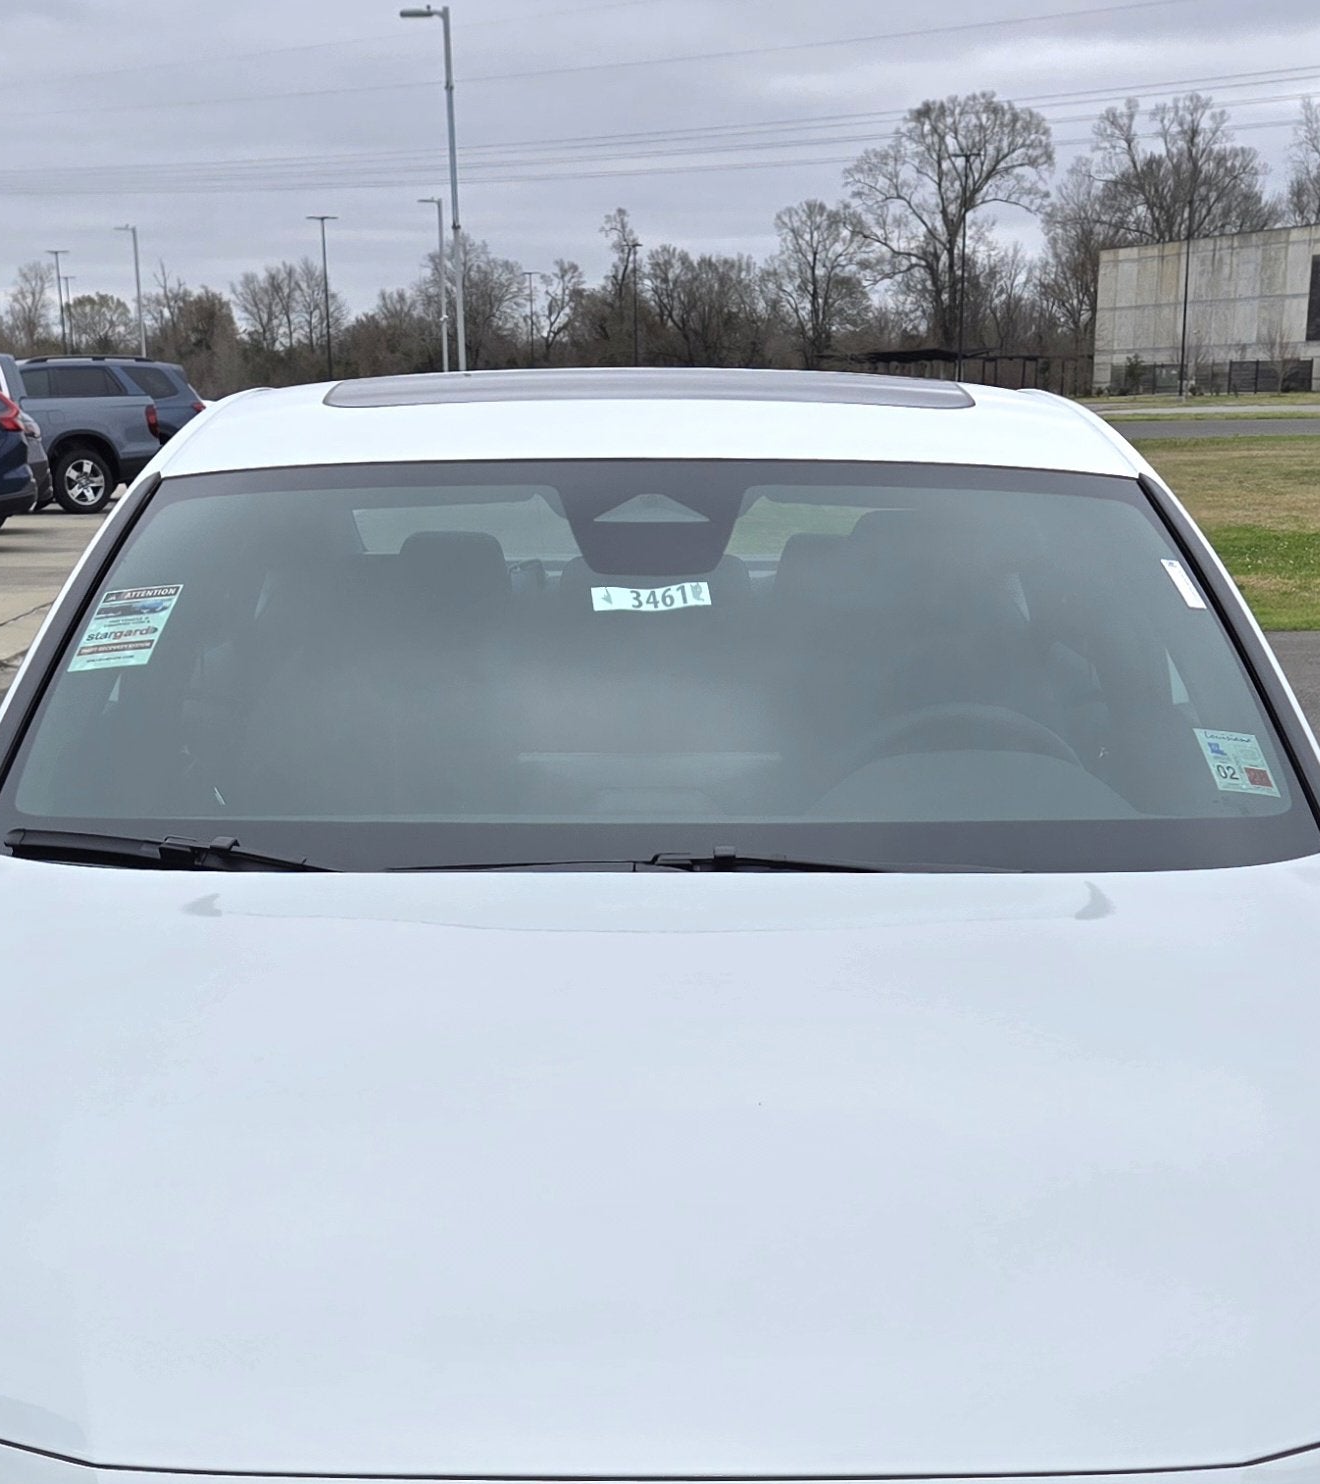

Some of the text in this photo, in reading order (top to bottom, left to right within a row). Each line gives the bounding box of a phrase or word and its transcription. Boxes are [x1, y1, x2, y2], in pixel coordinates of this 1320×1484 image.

[124, 587, 177, 599] ATTENTION
[629, 585, 689, 609] 3461
[1216, 764, 1240, 780] 02
